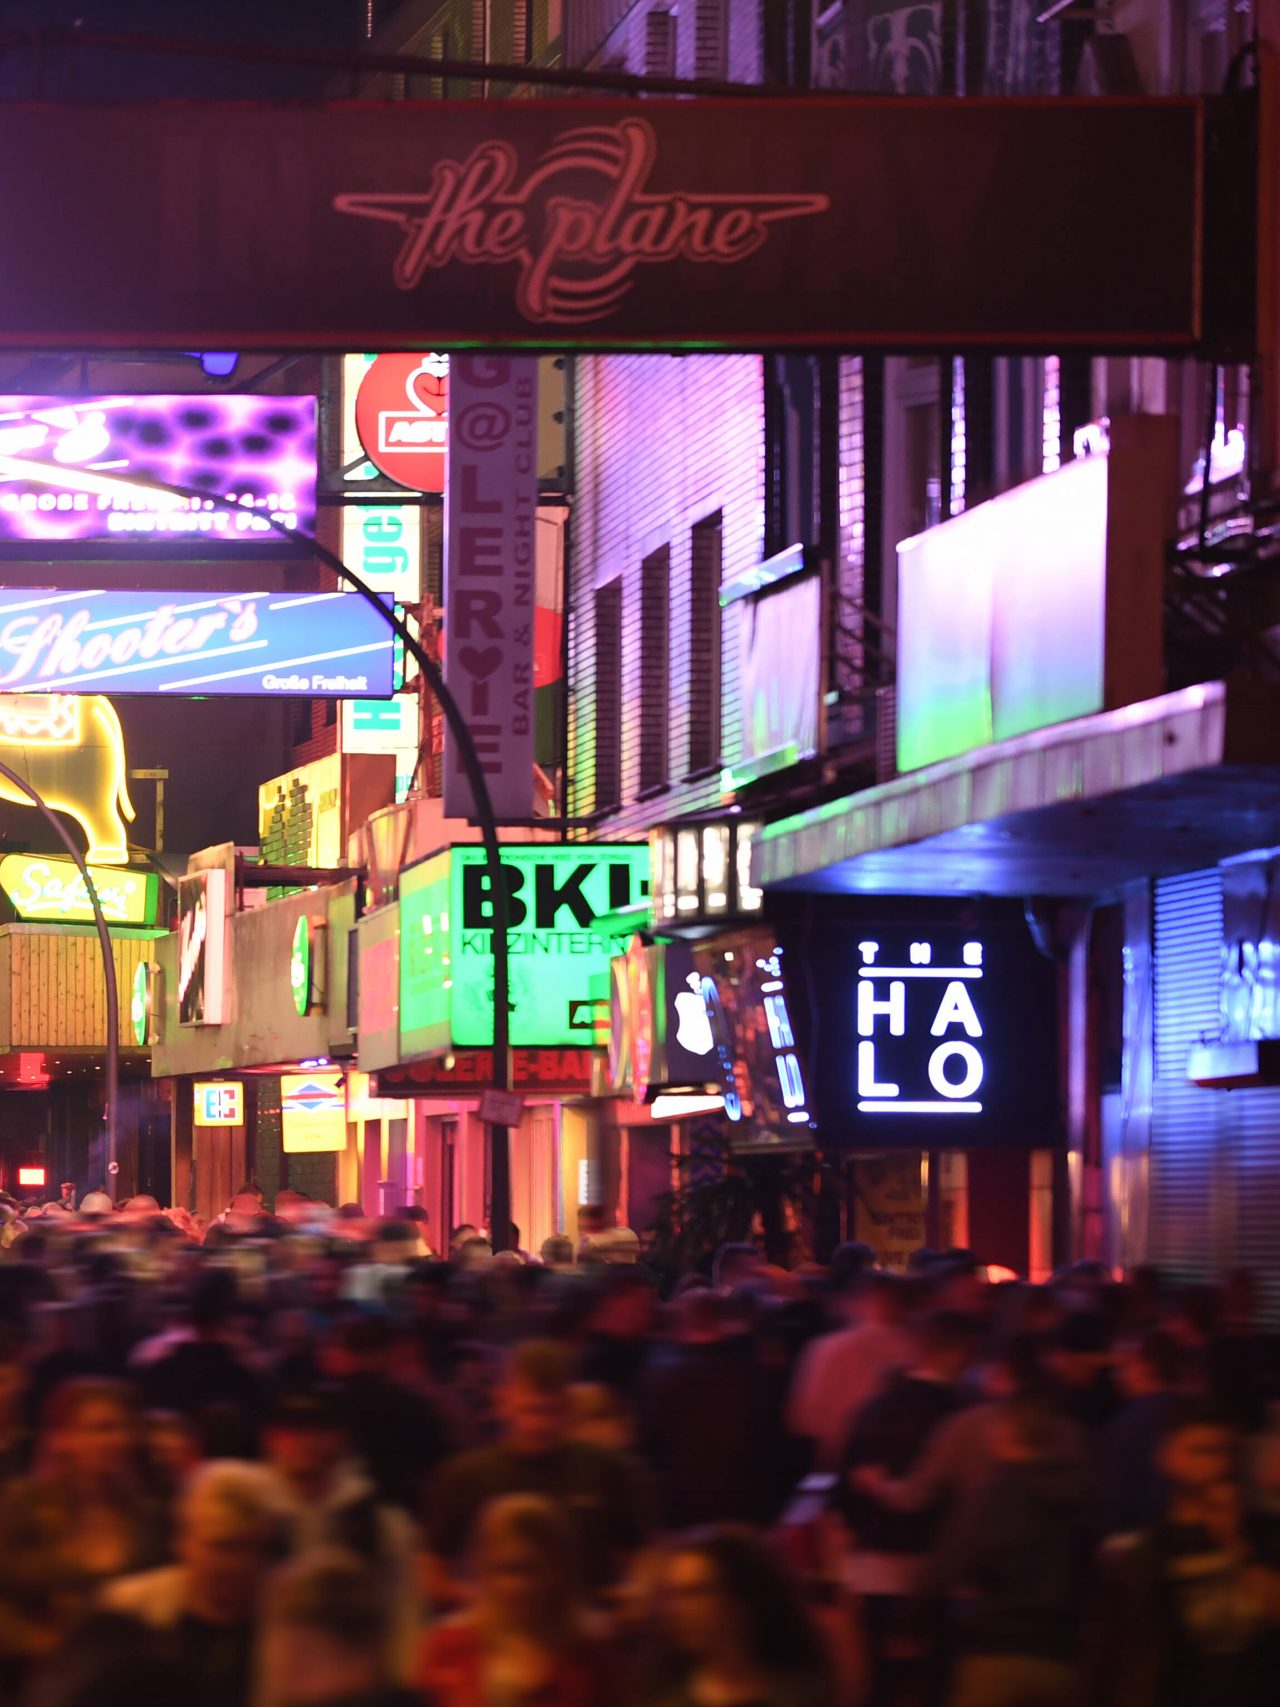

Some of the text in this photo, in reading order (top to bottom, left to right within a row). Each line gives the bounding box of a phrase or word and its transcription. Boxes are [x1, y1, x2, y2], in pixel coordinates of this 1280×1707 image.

[396, 119, 766, 321] the plane
[388, 421, 450, 443] AST
[514, 377, 534, 475] CLUB
[513, 495, 533, 606] NIGHT
[512, 662, 530, 736] BAR
[857, 941, 983, 966] THE
